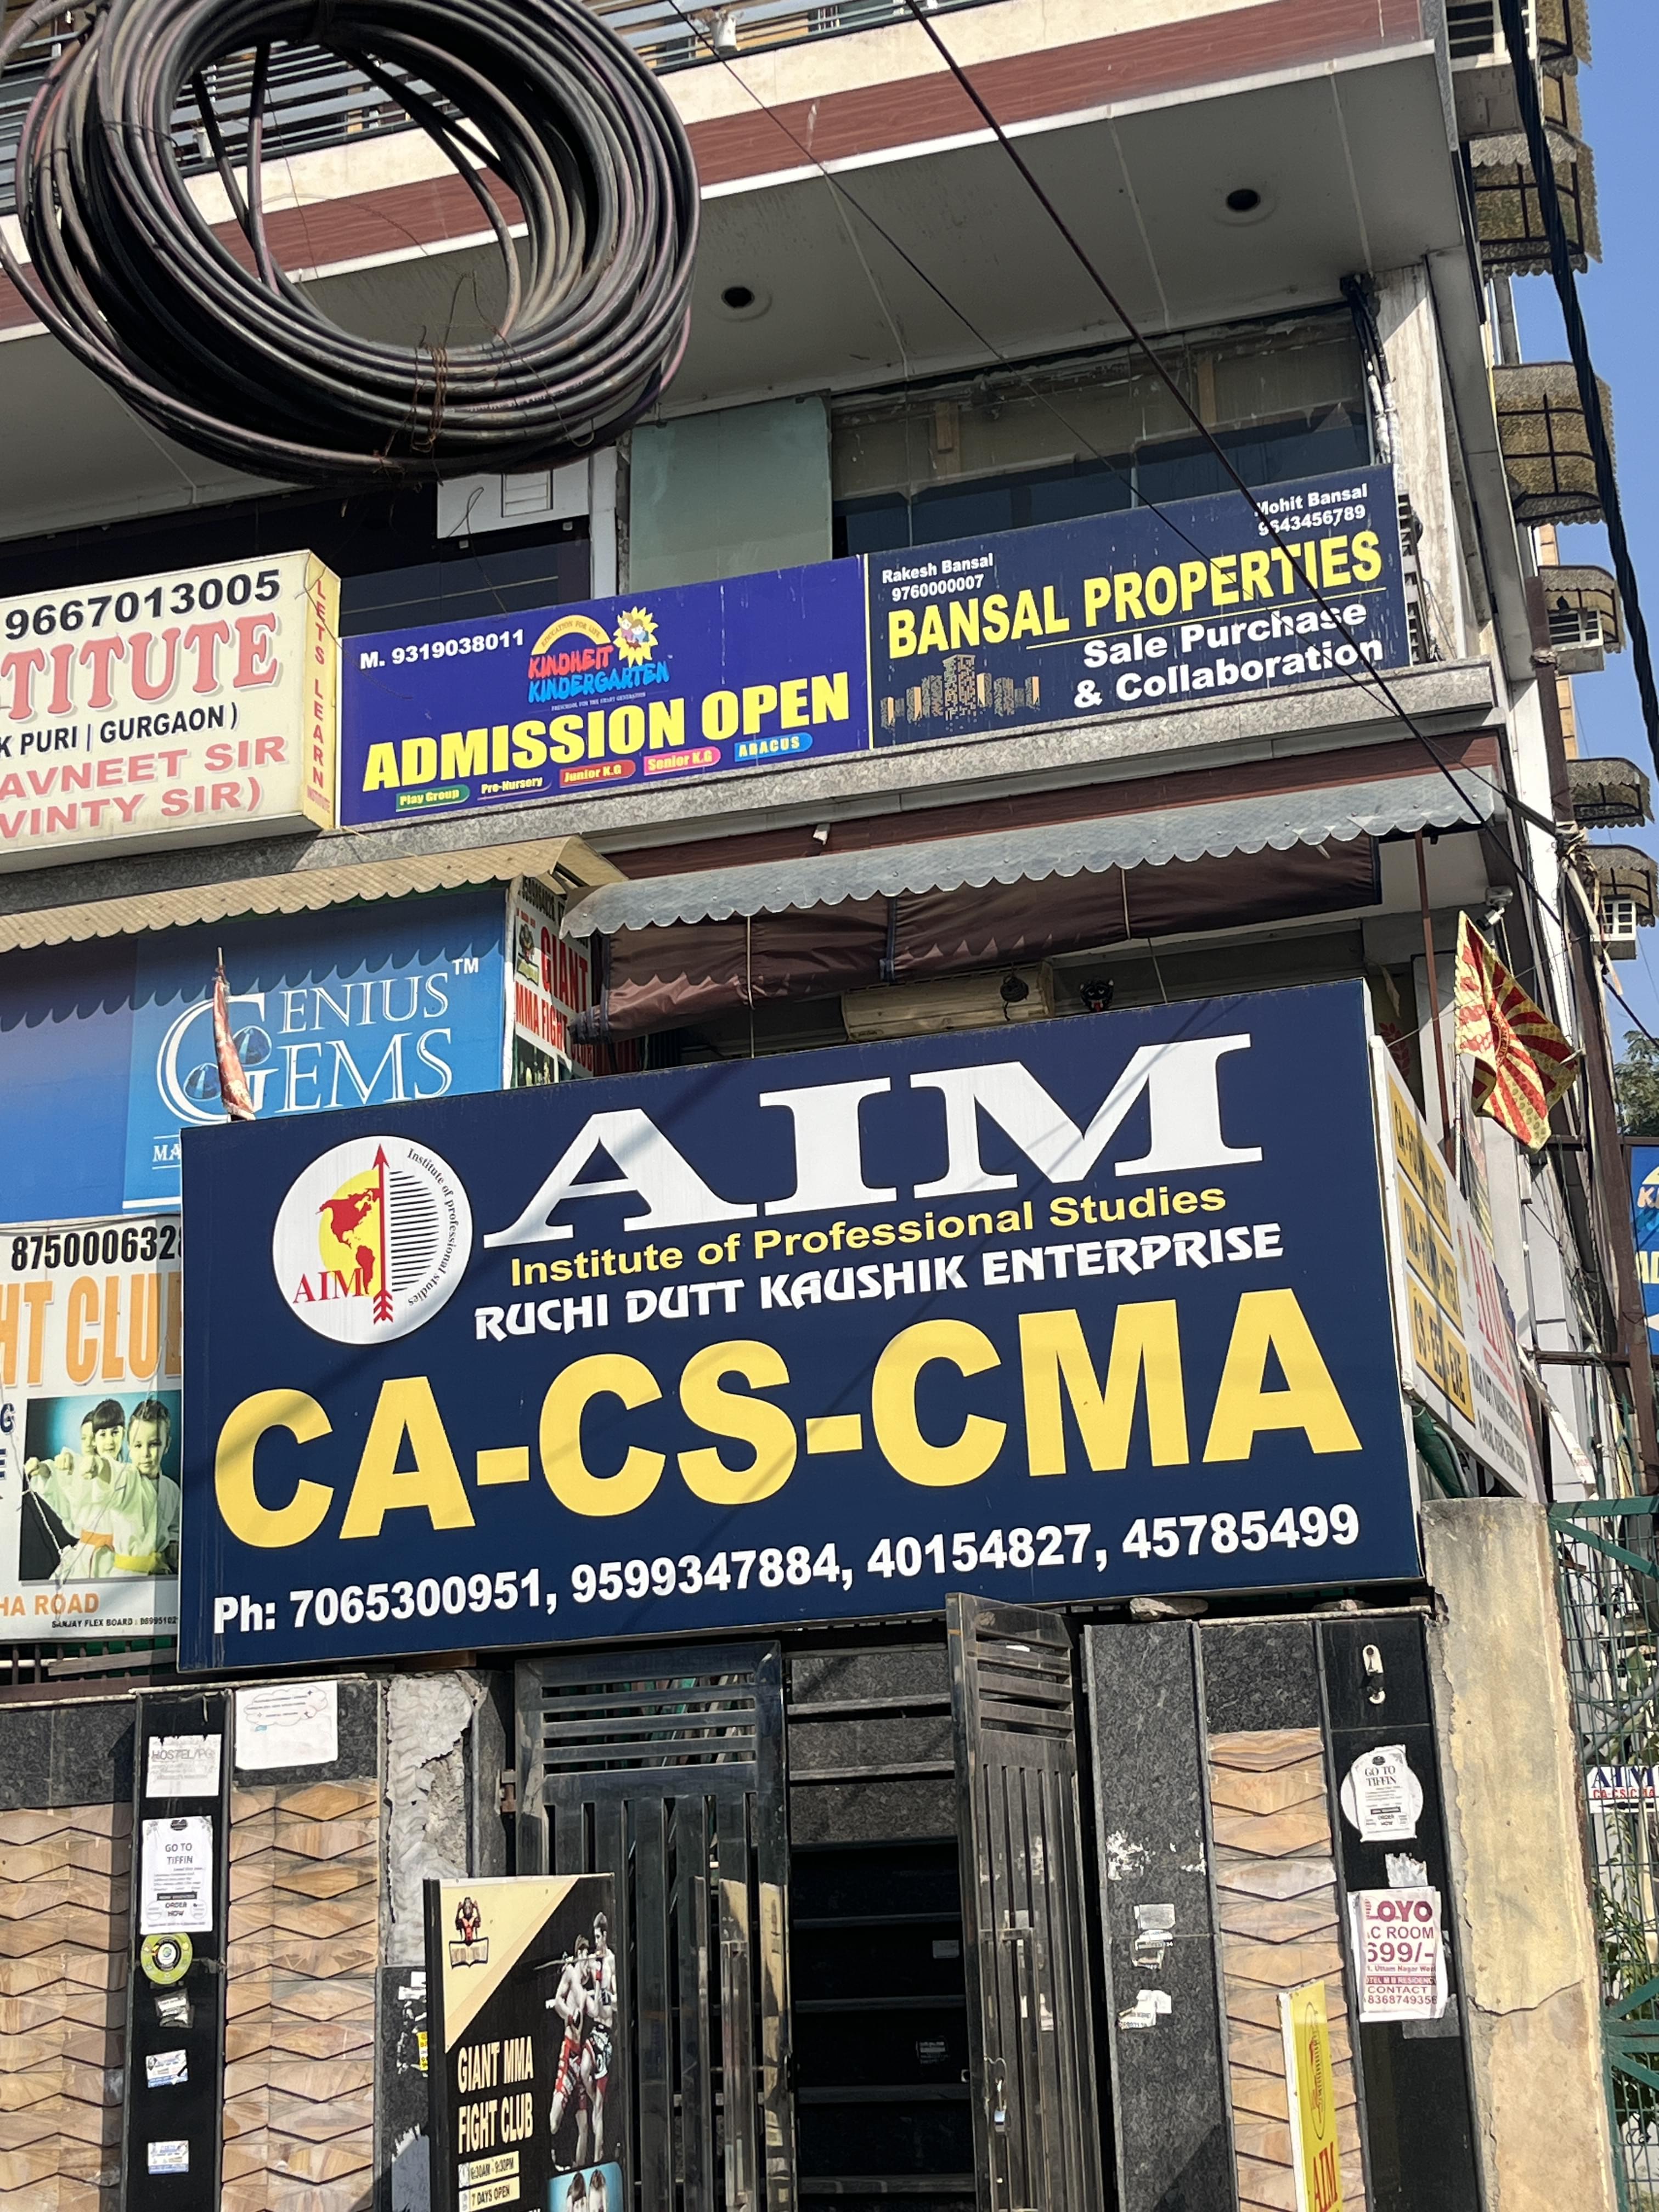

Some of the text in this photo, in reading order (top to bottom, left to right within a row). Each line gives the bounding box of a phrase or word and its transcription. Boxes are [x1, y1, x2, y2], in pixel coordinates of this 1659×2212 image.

[1254, 483, 1368, 517] Mohit Bansal
[882, 553, 994, 584] Rakesh Bansal
[5, 569, 280, 640] 9667013005
[888, 530, 1383, 659] BANSAL PROPERTIES
[891, 574, 984, 602] 9760000007
[360, 628, 524, 669] M. 9319038011
[1083, 601, 1367, 668] Sale Purchase
[528, 645, 614, 679] KINDHEIT
[1074, 637, 1383, 708] & Collaboration
[528, 661, 670, 703] KINDERGARTEN
[20, 726, 77, 755] PURI
[363, 670, 850, 792] ADMISSION OPEN
[738, 736, 800, 758] ABACUS
[204, 736, 286, 771] SIR
[647, 755, 690, 772] Senior
[564, 767, 600, 783] Junior
[161, 777, 261, 817] SIR)
[399, 788, 460, 806] Play Group
[541, 926, 588, 1013] GIANT
[484, 1033, 1263, 1248] AIM
[407, 1148, 444, 1185] Institute
[442, 1185, 454, 1197] of
[12, 1224, 182, 1271] 875000632
[438, 1198, 460, 1275] professional
[511, 1186, 1226, 1286] Institute of Professional Studies
[293, 1268, 365, 1304] AIM
[475, 1223, 1284, 1341] RUCHI DUTT KAUSHIK ENTERPRISE
[215, 1288, 1363, 1548] CA-CS-CMA
[213, 1503, 1359, 1634] Ph: 7065300951, 9599347884, 40154827, 45785499
[35, 1593, 99, 1615] ROAD
[84, 1618, 104, 1627] FLEX
[106, 1618, 133, 1626] BOARD
[1364, 1765, 1396, 1776] GO TO
[1365, 1776, 1397, 1786] TIFFIN
[165, 1844, 178, 1852] GO
[167, 1855, 193, 1864] TIFFIN
[1377, 1900, 1432, 1922] OYO
[1367, 1926, 1434, 1939] C ROOM
[458, 2041, 500, 2094] GIANT
[504, 2036, 534, 2084] MMA
[459, 2092, 533, 2154] FIGHT CLUB
